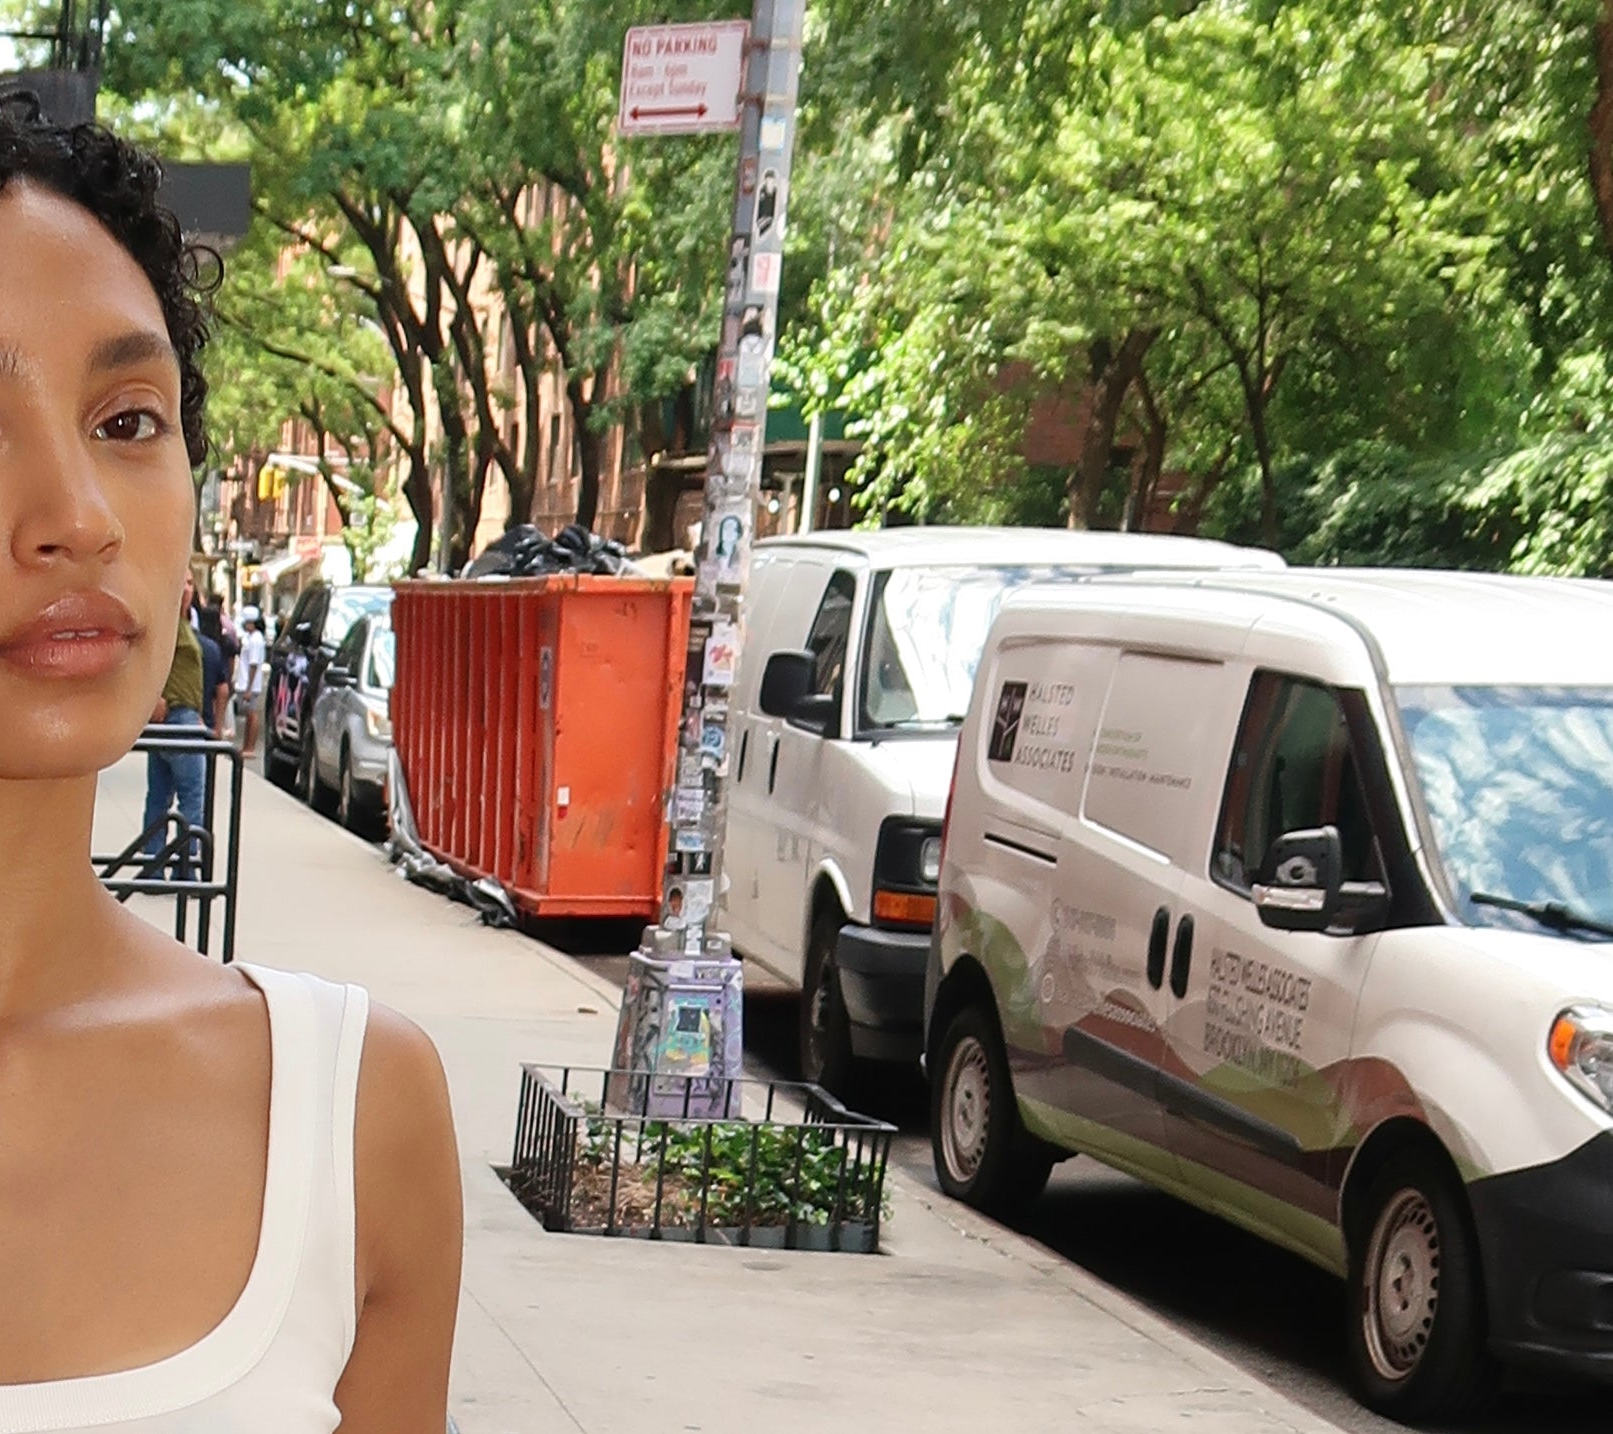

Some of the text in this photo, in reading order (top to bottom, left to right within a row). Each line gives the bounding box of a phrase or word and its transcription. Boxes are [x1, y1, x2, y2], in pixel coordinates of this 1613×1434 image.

[632, 35, 717, 56] NO PARKING
[1028, 681, 1075, 707] HALSTED
[1022, 715, 1060, 737] WELLES
[1014, 745, 1076, 773] ASSOCIATES
